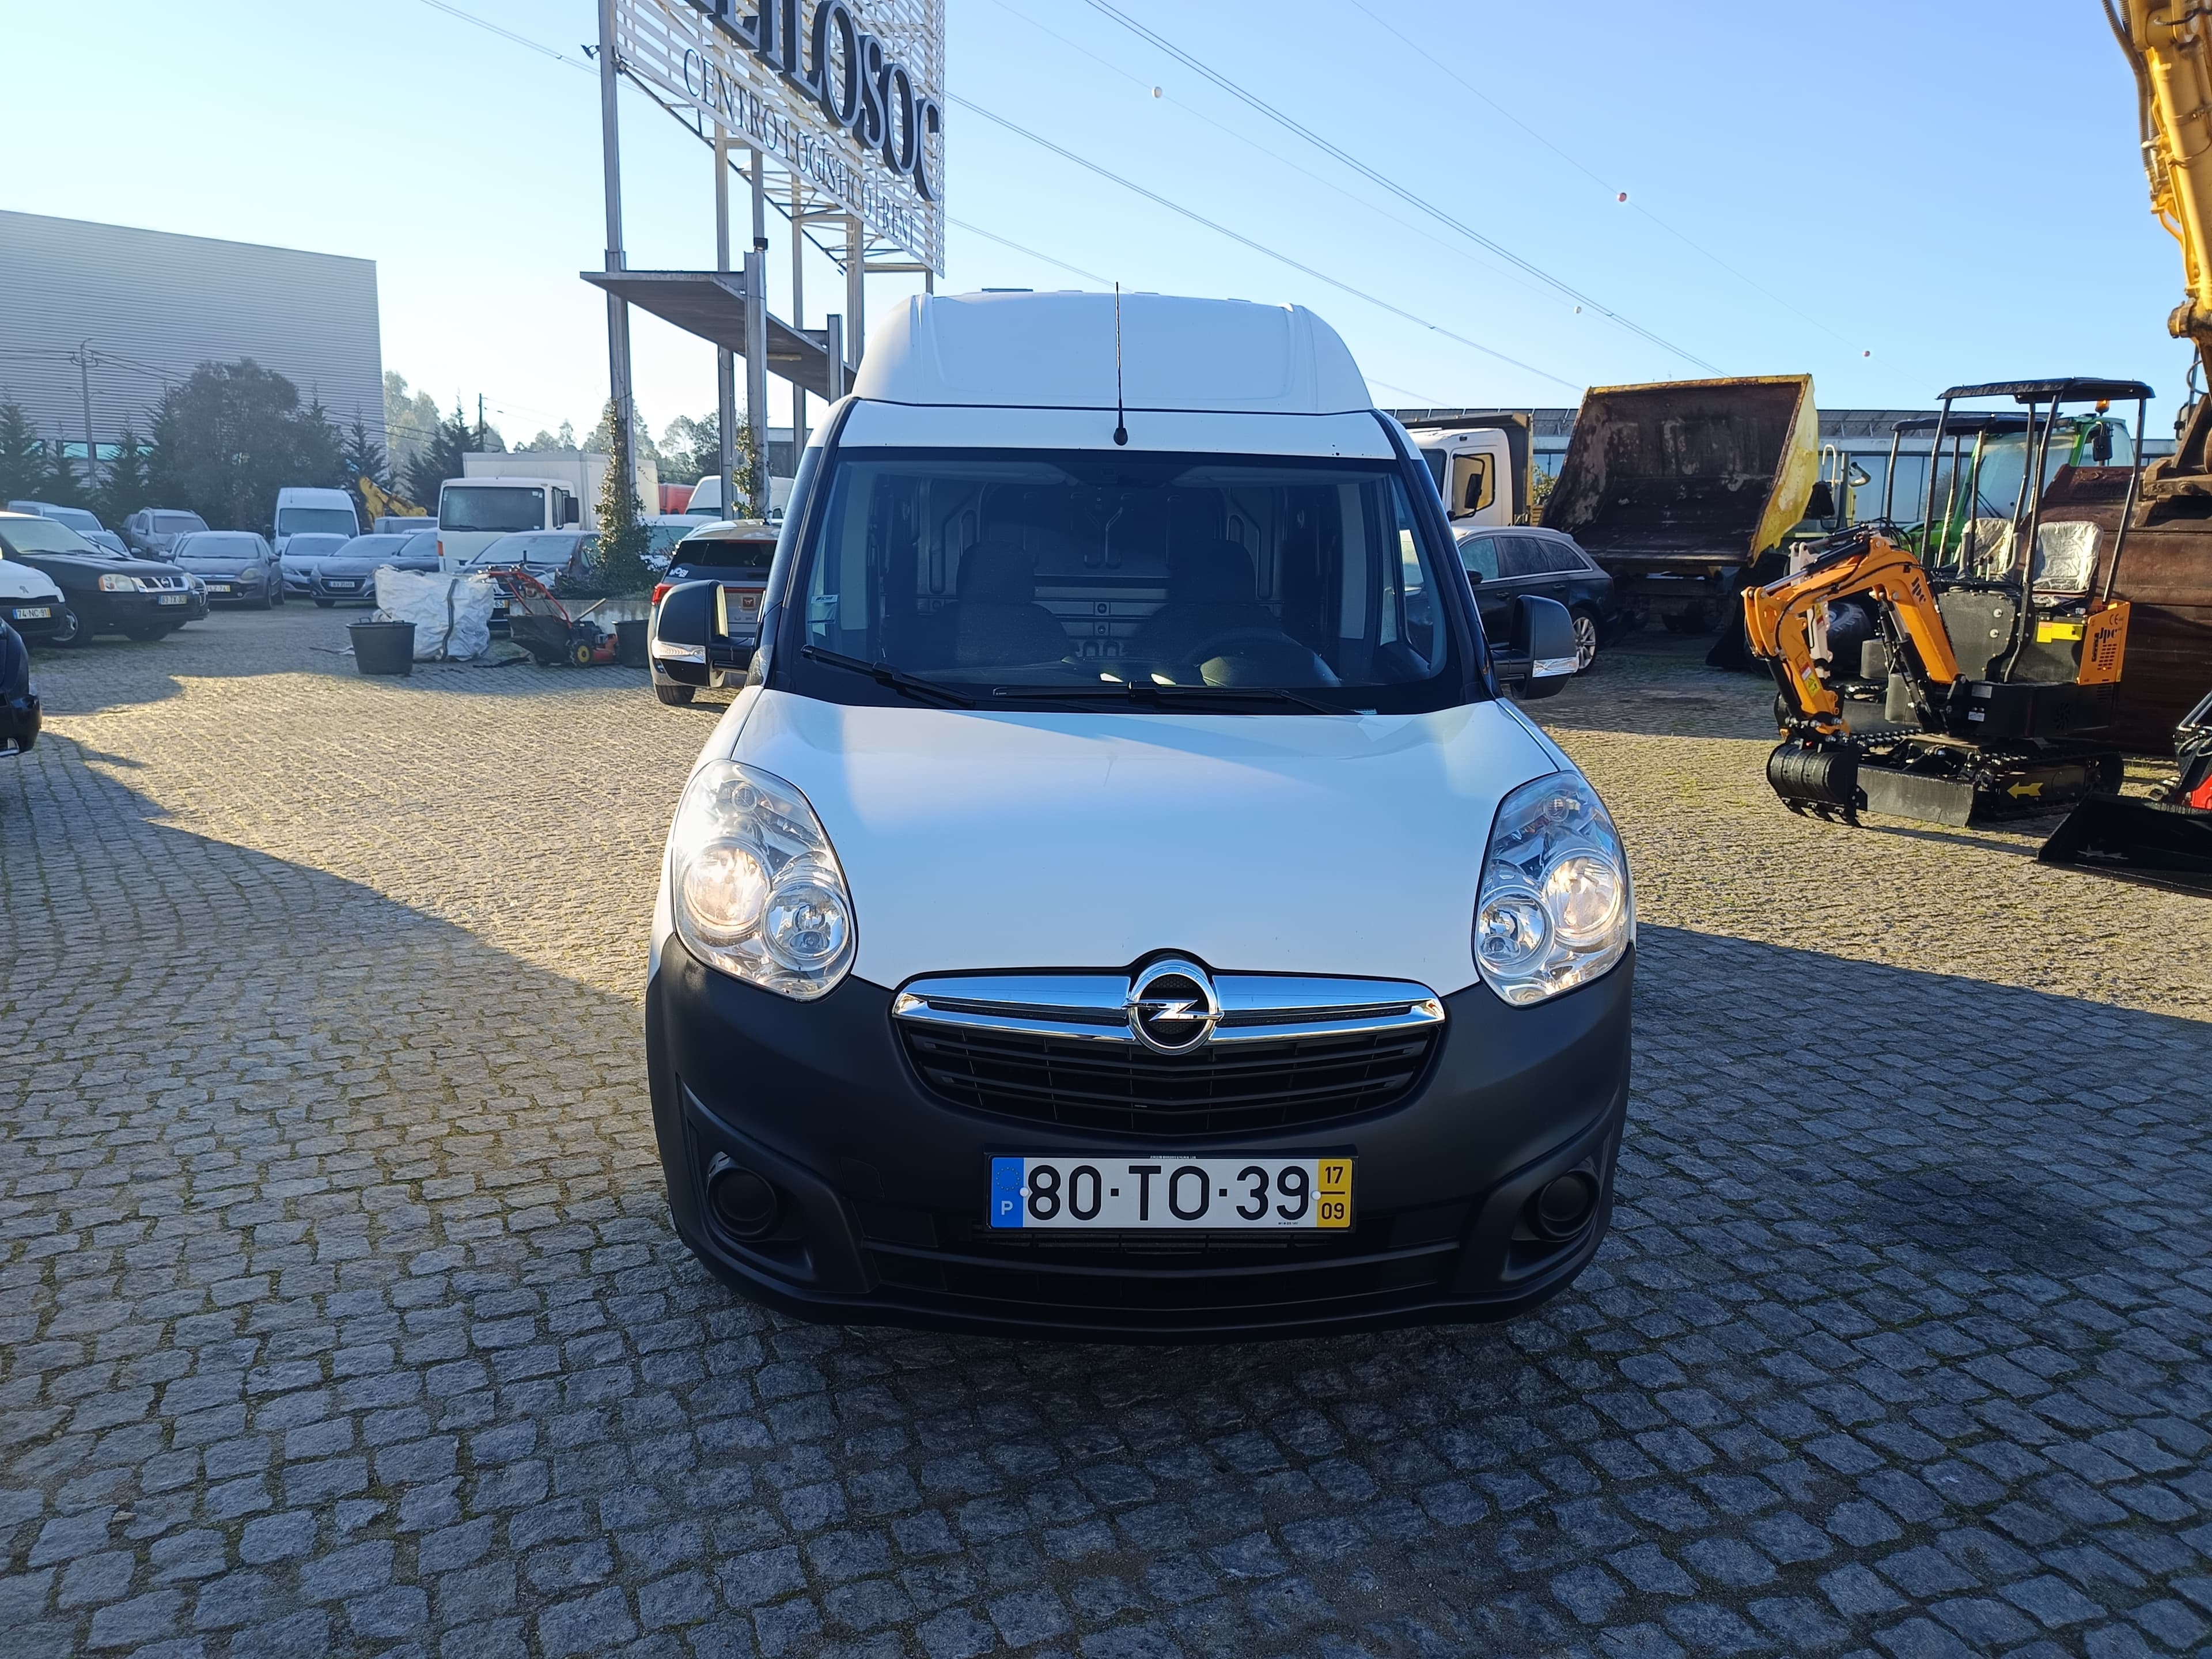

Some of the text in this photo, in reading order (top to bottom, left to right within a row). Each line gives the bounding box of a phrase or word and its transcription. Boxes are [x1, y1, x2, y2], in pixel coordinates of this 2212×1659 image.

[684, 48, 778, 150] CENTRO
[1325, 1166, 1344, 1184] 17
[1001, 1200, 1014, 1216] P
[1321, 1202, 1345, 1220] 09
